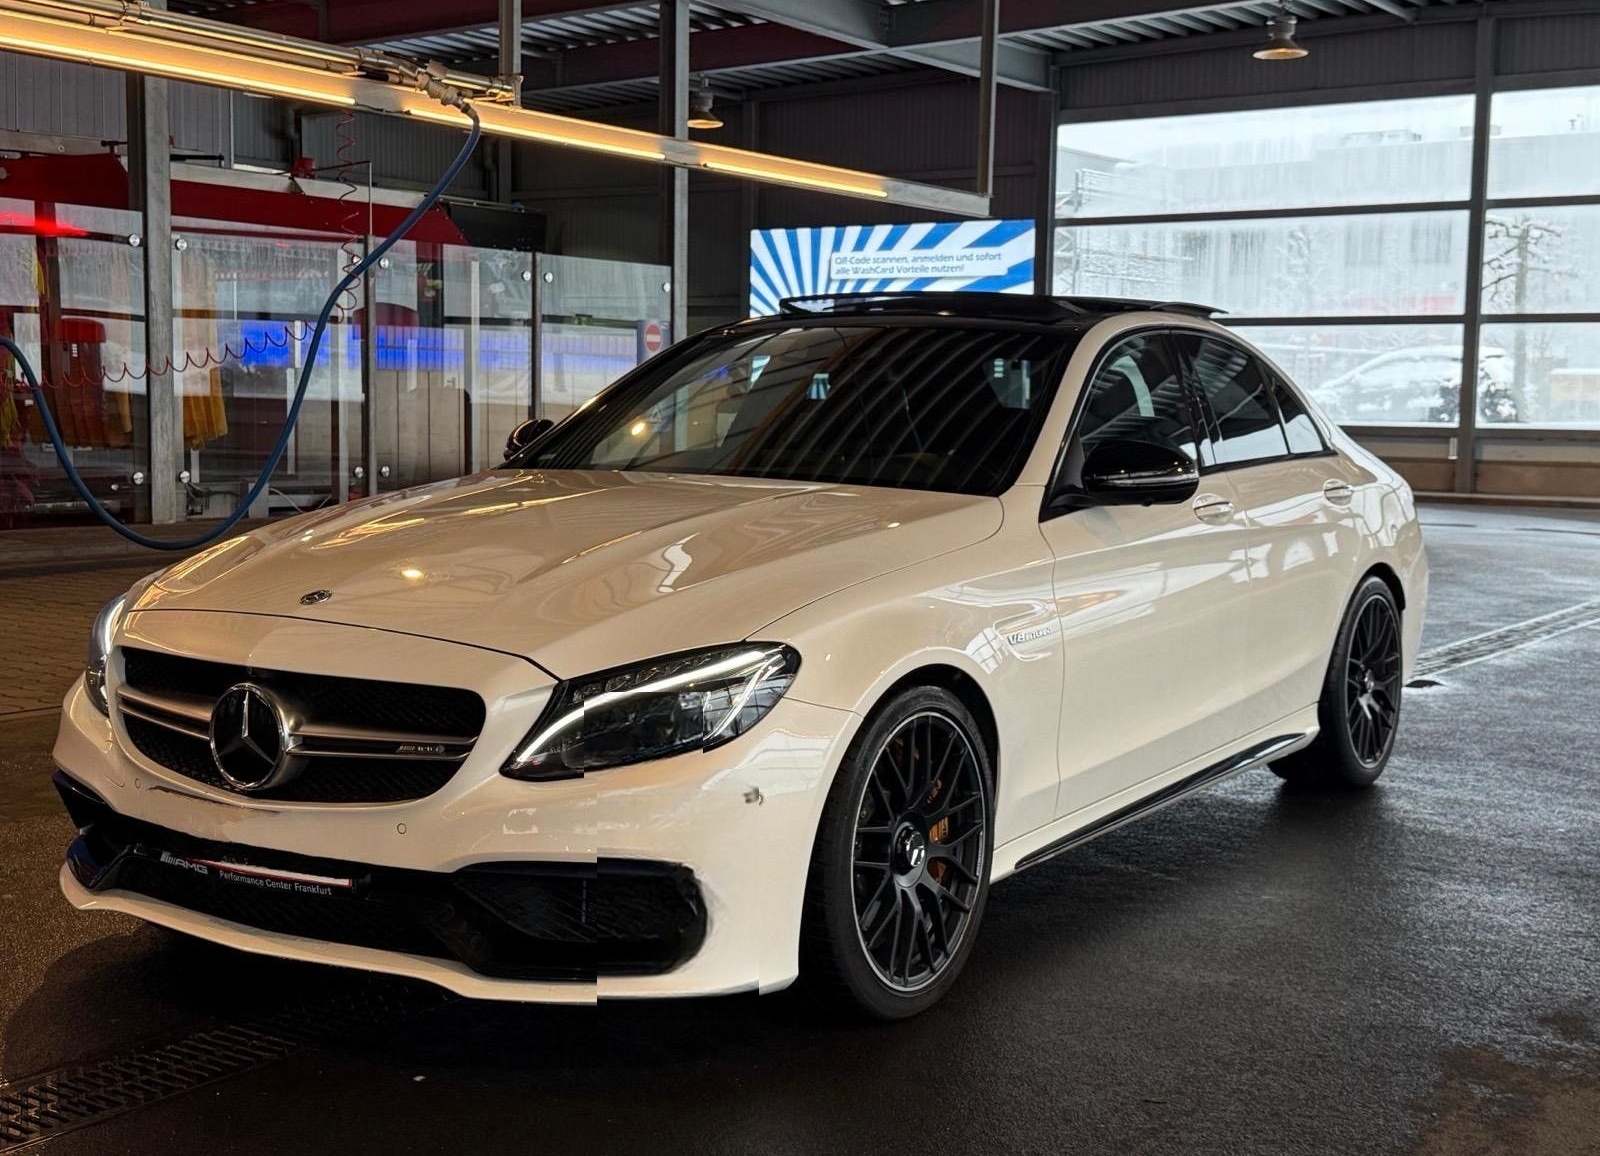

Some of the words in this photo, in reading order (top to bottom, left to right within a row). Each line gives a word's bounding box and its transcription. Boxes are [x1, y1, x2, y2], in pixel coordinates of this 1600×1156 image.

[911, 254, 954, 262] anmelden
[956, 253, 974, 261] und
[976, 252, 1001, 260] sofort
[835, 267, 851, 275] alle
[852, 266, 895, 275] WashCard
[896, 264, 929, 274] Vorteile
[219, 869, 265, 887] Performance
[265, 878, 292, 891] Center
[294, 882, 332, 896] Frankfurt
